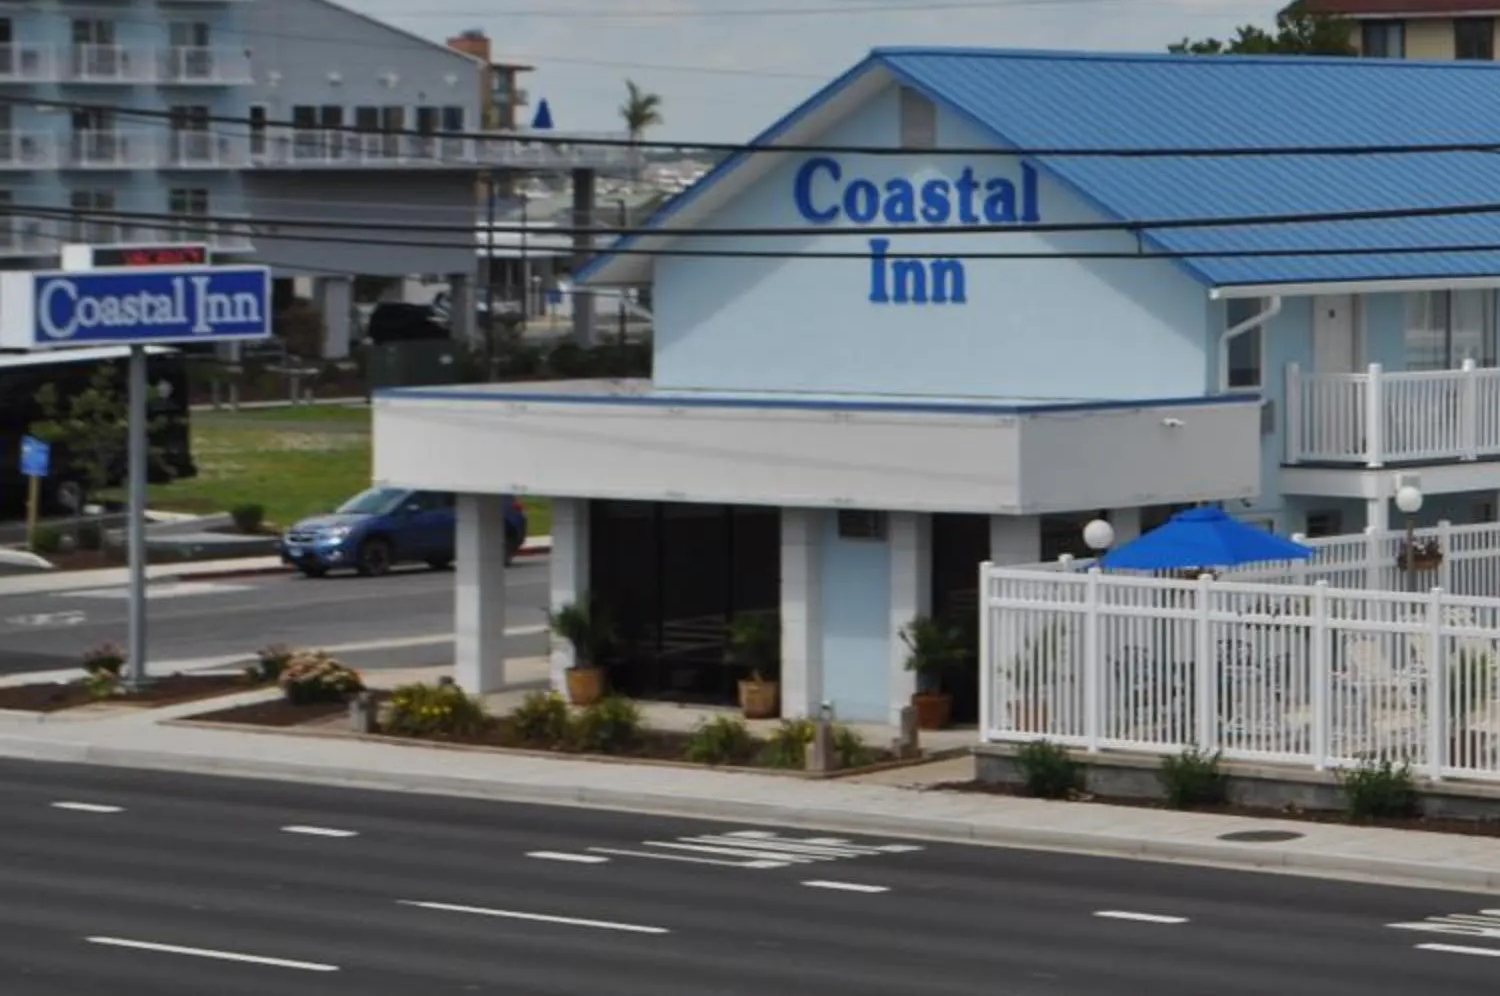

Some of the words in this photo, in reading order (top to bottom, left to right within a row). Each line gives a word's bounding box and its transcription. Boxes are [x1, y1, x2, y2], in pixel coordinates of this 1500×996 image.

[794, 158, 1041, 223] Coastal
[868, 239, 966, 303] Inn
[41, 277, 185, 338] Coastal
[191, 277, 260, 333] Inn
